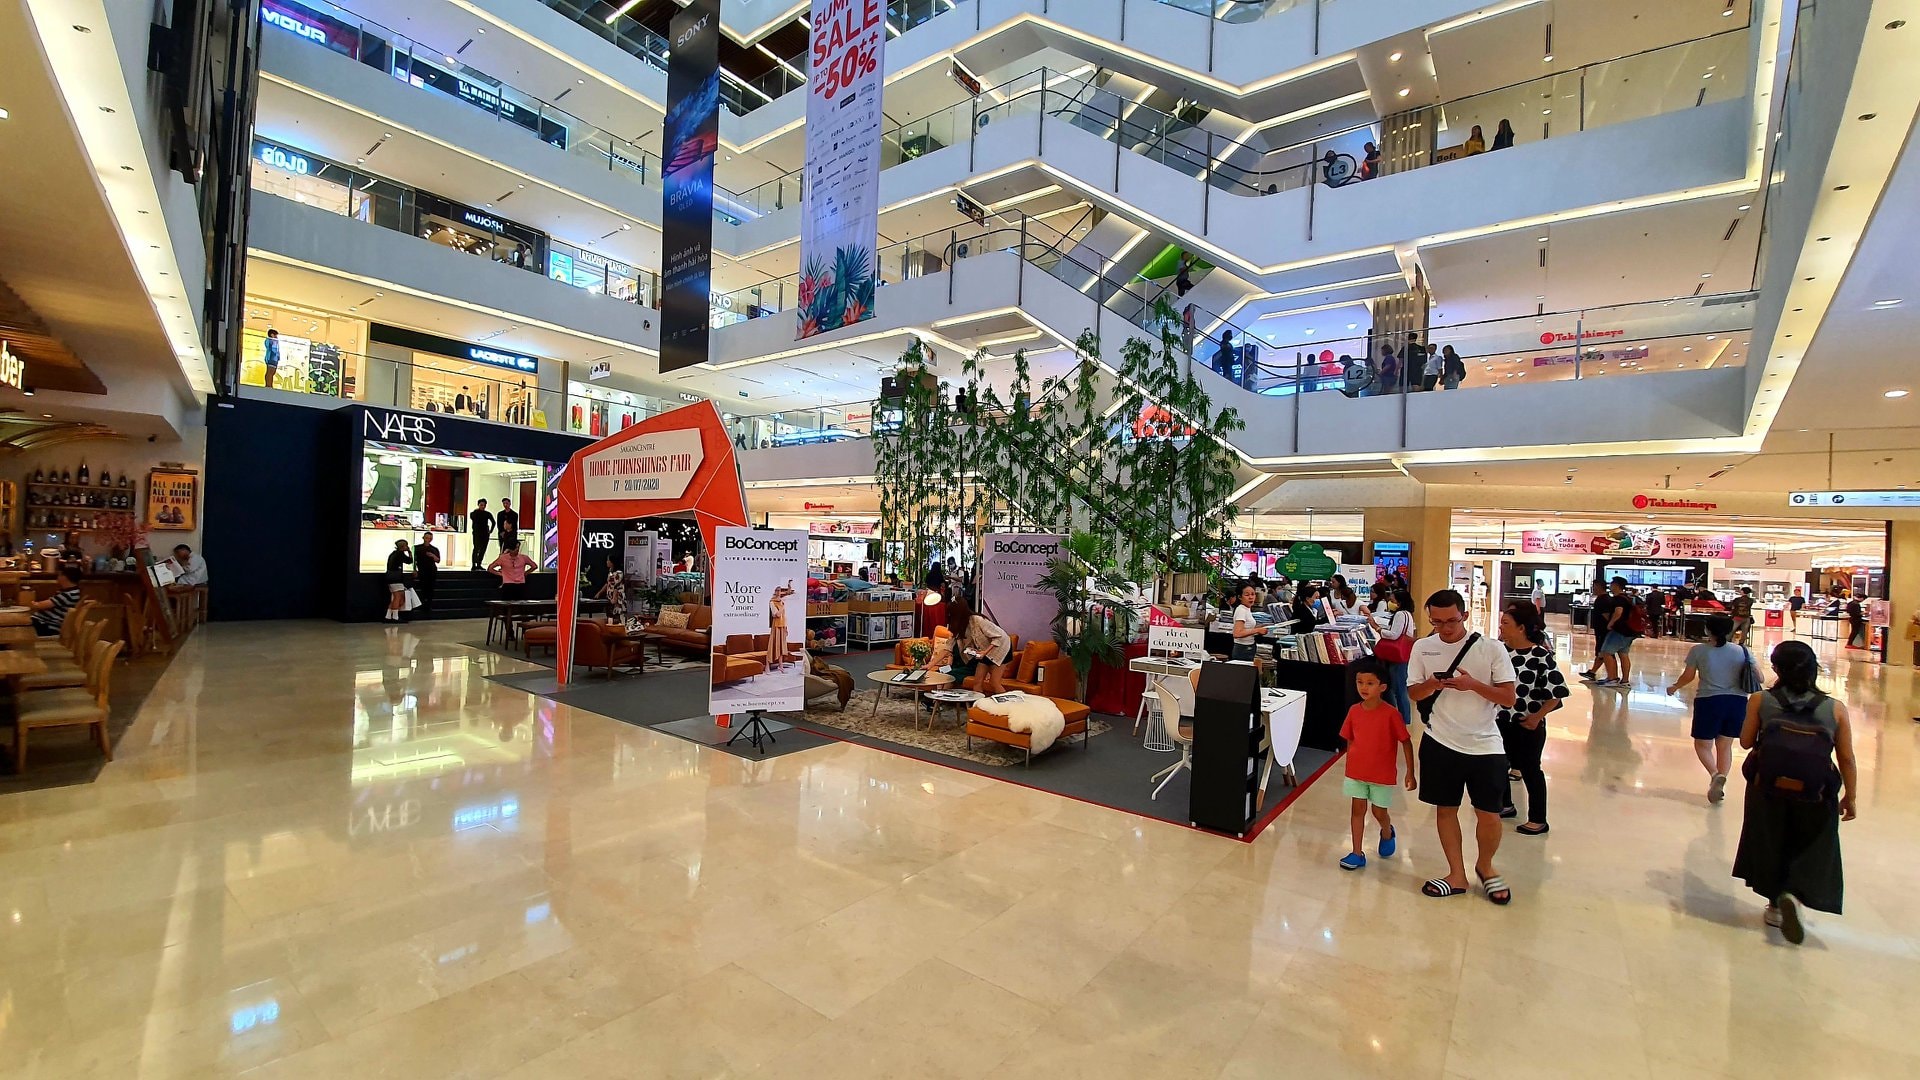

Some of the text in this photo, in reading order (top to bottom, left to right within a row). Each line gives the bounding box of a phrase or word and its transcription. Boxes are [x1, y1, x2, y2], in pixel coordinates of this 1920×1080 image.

[677, 12, 710, 47] SONY
[813, 0, 880, 68] SALE
[1331, 164, 1347, 177] L3
[670, 179, 704, 206] BRAVIA
[464, 211, 505, 233] MUJOSH
[470, 347, 516, 366] LACOSTE
[0, 339, 25, 390] ber
[1347, 369, 1364, 381] L2
[363, 408, 436, 445] NARS
[589, 453, 691, 477] HOME FURNISHINGS FAIR
[152, 480, 191, 490] ALL FOOD
[613, 479, 620, 492] 17
[152, 488, 165, 496] ALL
[170, 497, 190, 505] AWAY
[1648, 498, 1717, 511] Takashimaya
[581, 531, 615, 550] NARS
[725, 535, 799, 554] BoConcept
[994, 540, 1059, 558] BoConcept
[662, 565, 671, 574] 50
[997, 571, 1019, 581] More
[868, 572, 877, 582] 50
[724, 580, 762, 594] More
[1010, 583, 1025, 592] you
[730, 595, 755, 608] you
[816, 603, 832, 612] NIN
[886, 601, 899, 610] NIN
[1166, 628, 1177, 637] TẤT
